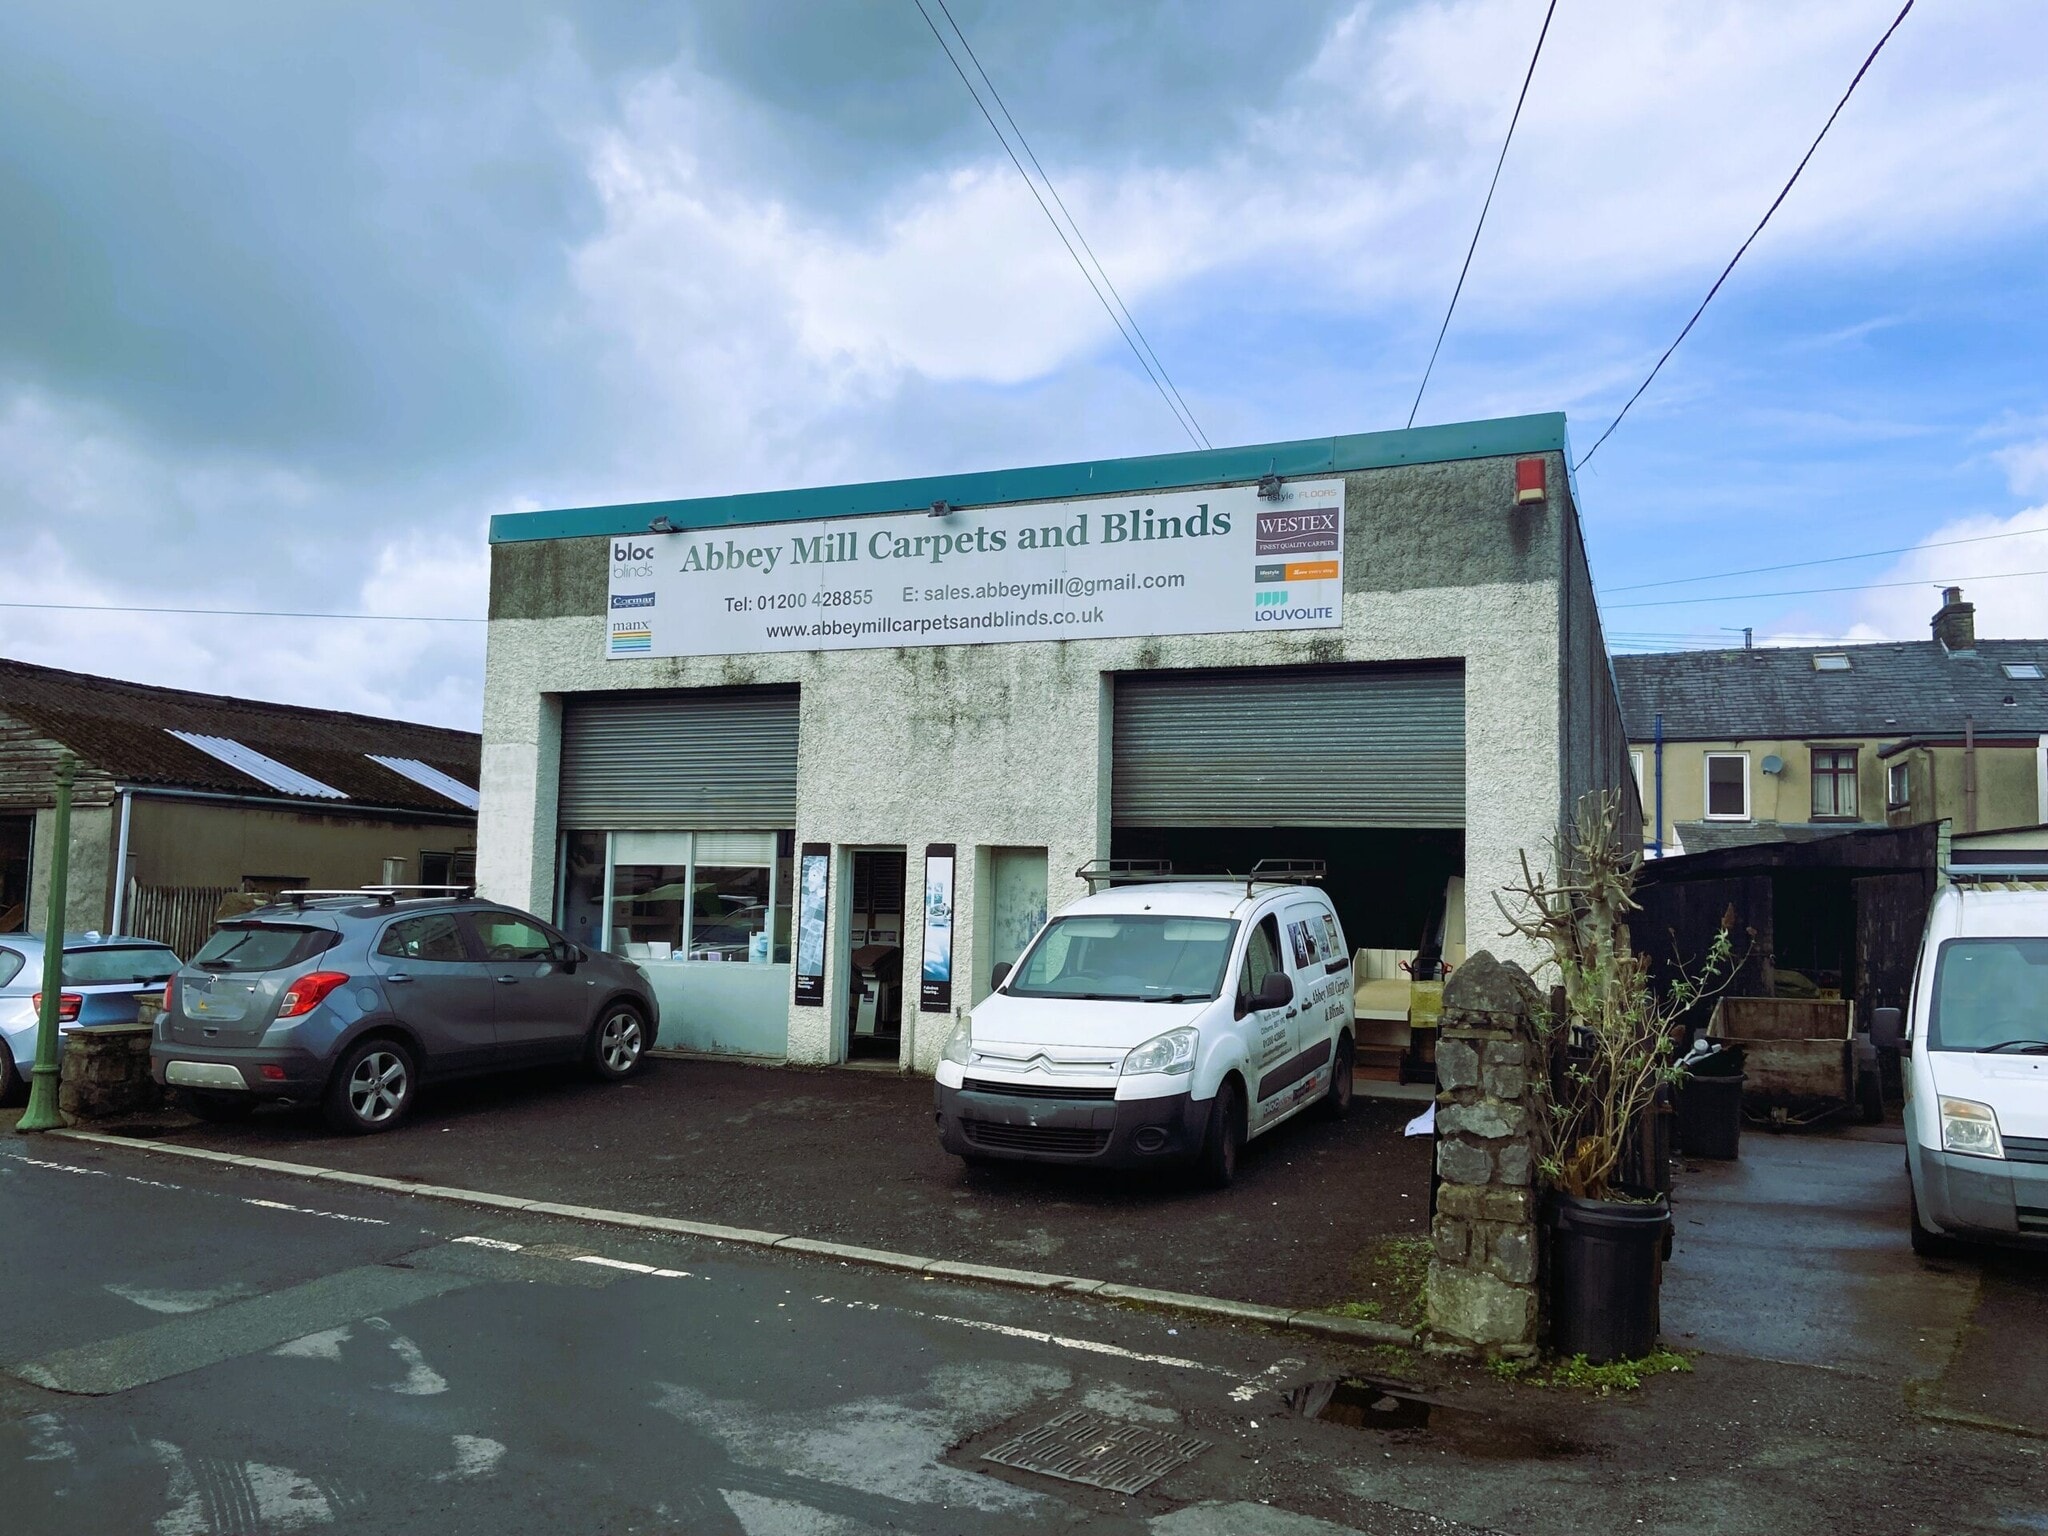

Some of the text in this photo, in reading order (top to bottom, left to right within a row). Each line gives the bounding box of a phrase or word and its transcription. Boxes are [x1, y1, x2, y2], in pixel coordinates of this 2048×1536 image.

[1259, 514, 1335, 534] WESTEX
[679, 503, 1232, 575] Abbey Mill Carpets and Blinds
[1260, 540, 1335, 551] FINEST QUALITY CARPETS
[614, 542, 654, 562] bloc
[613, 562, 653, 579] blinds
[724, 573, 1185, 613] Tel: 01200 428855 E: sales.abbeymill@gmail.com
[766, 607, 1104, 639] www.abbeymillcarpetsandblinds.co.uk
[1255, 607, 1333, 621] LOUVOLITE
[613, 621, 649, 632] manx
